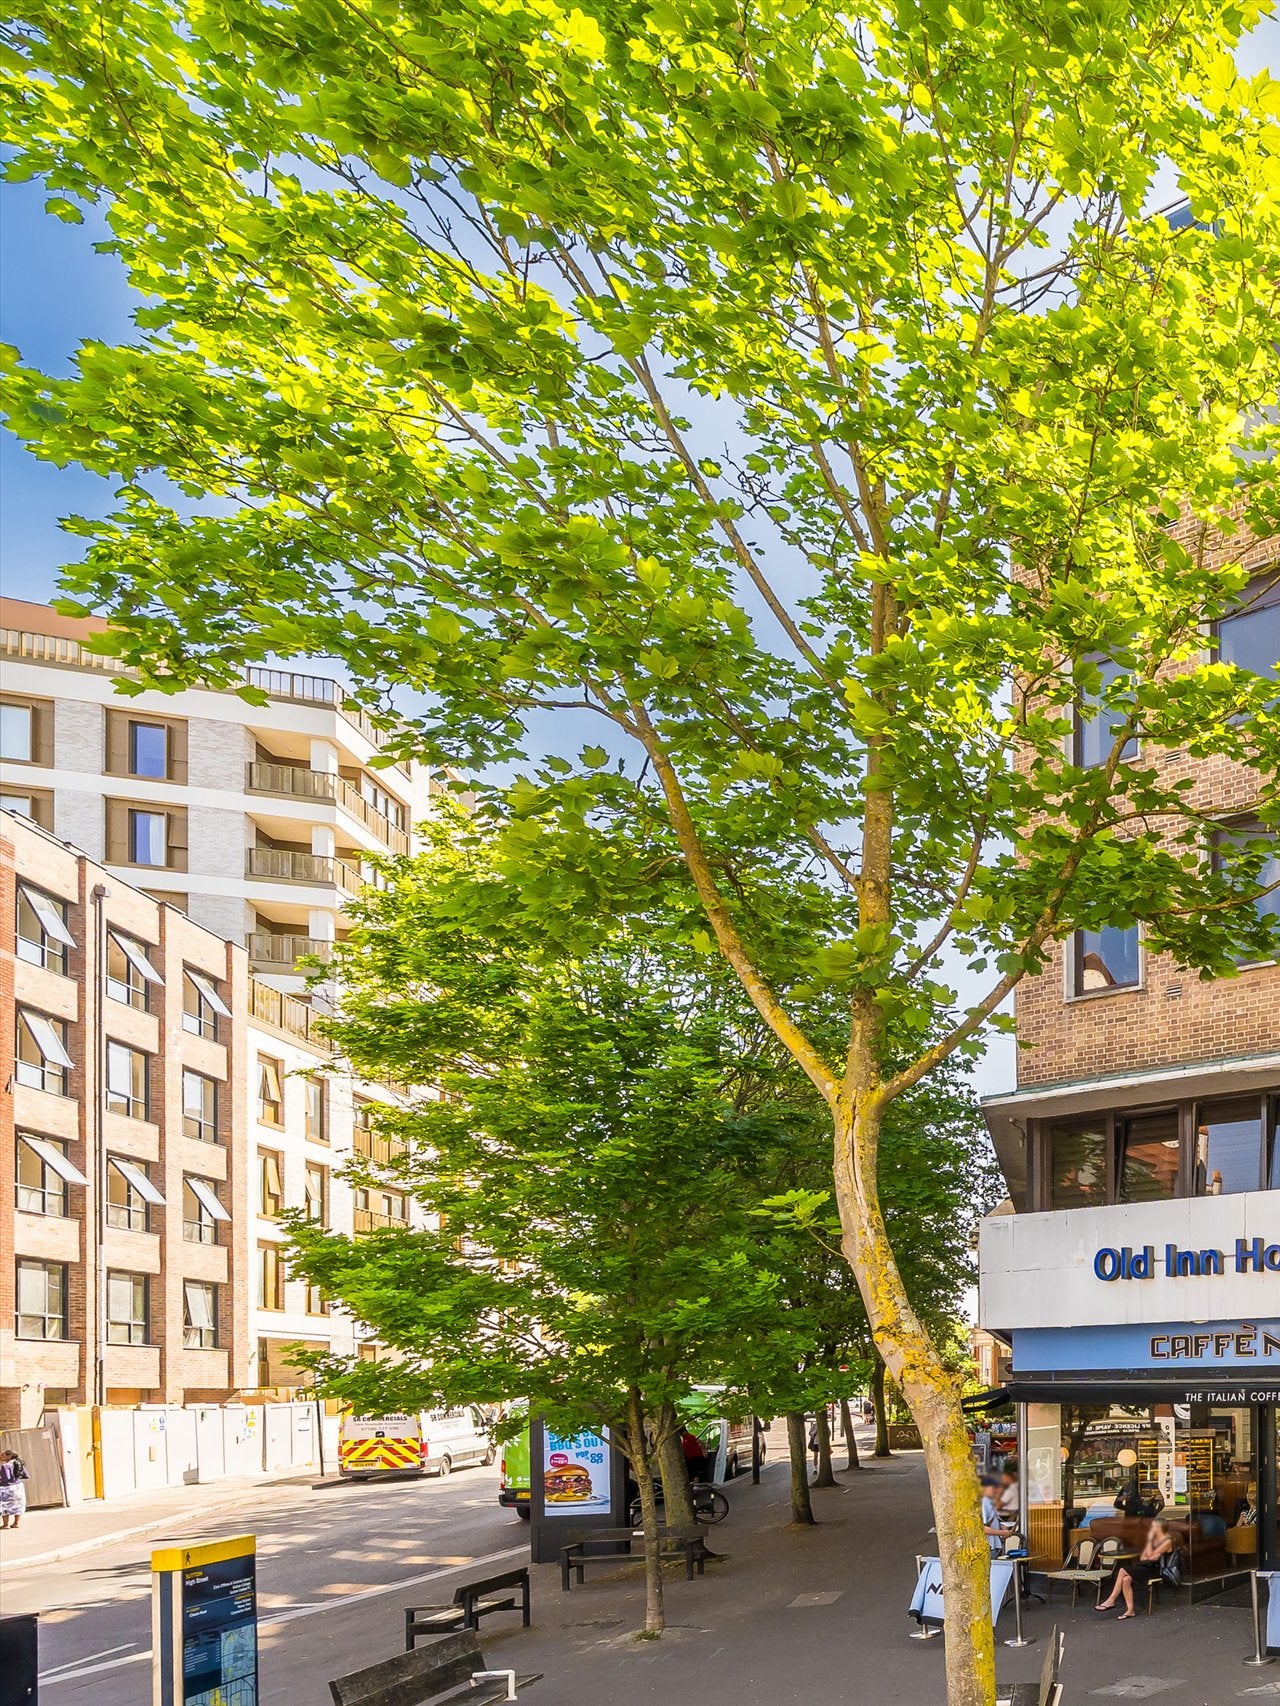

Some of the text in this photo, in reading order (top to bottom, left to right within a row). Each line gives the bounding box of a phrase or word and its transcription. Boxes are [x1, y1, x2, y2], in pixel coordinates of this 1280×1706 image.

[1094, 1246, 1155, 1282] Old
[1165, 1243, 1224, 1278] Inn
[1149, 1323, 1257, 1360] CAFFÈ
[1185, 1393, 1203, 1402] THE
[1207, 1392, 1246, 1402] ITALIAN
[575, 1450, 590, 1459] POP
